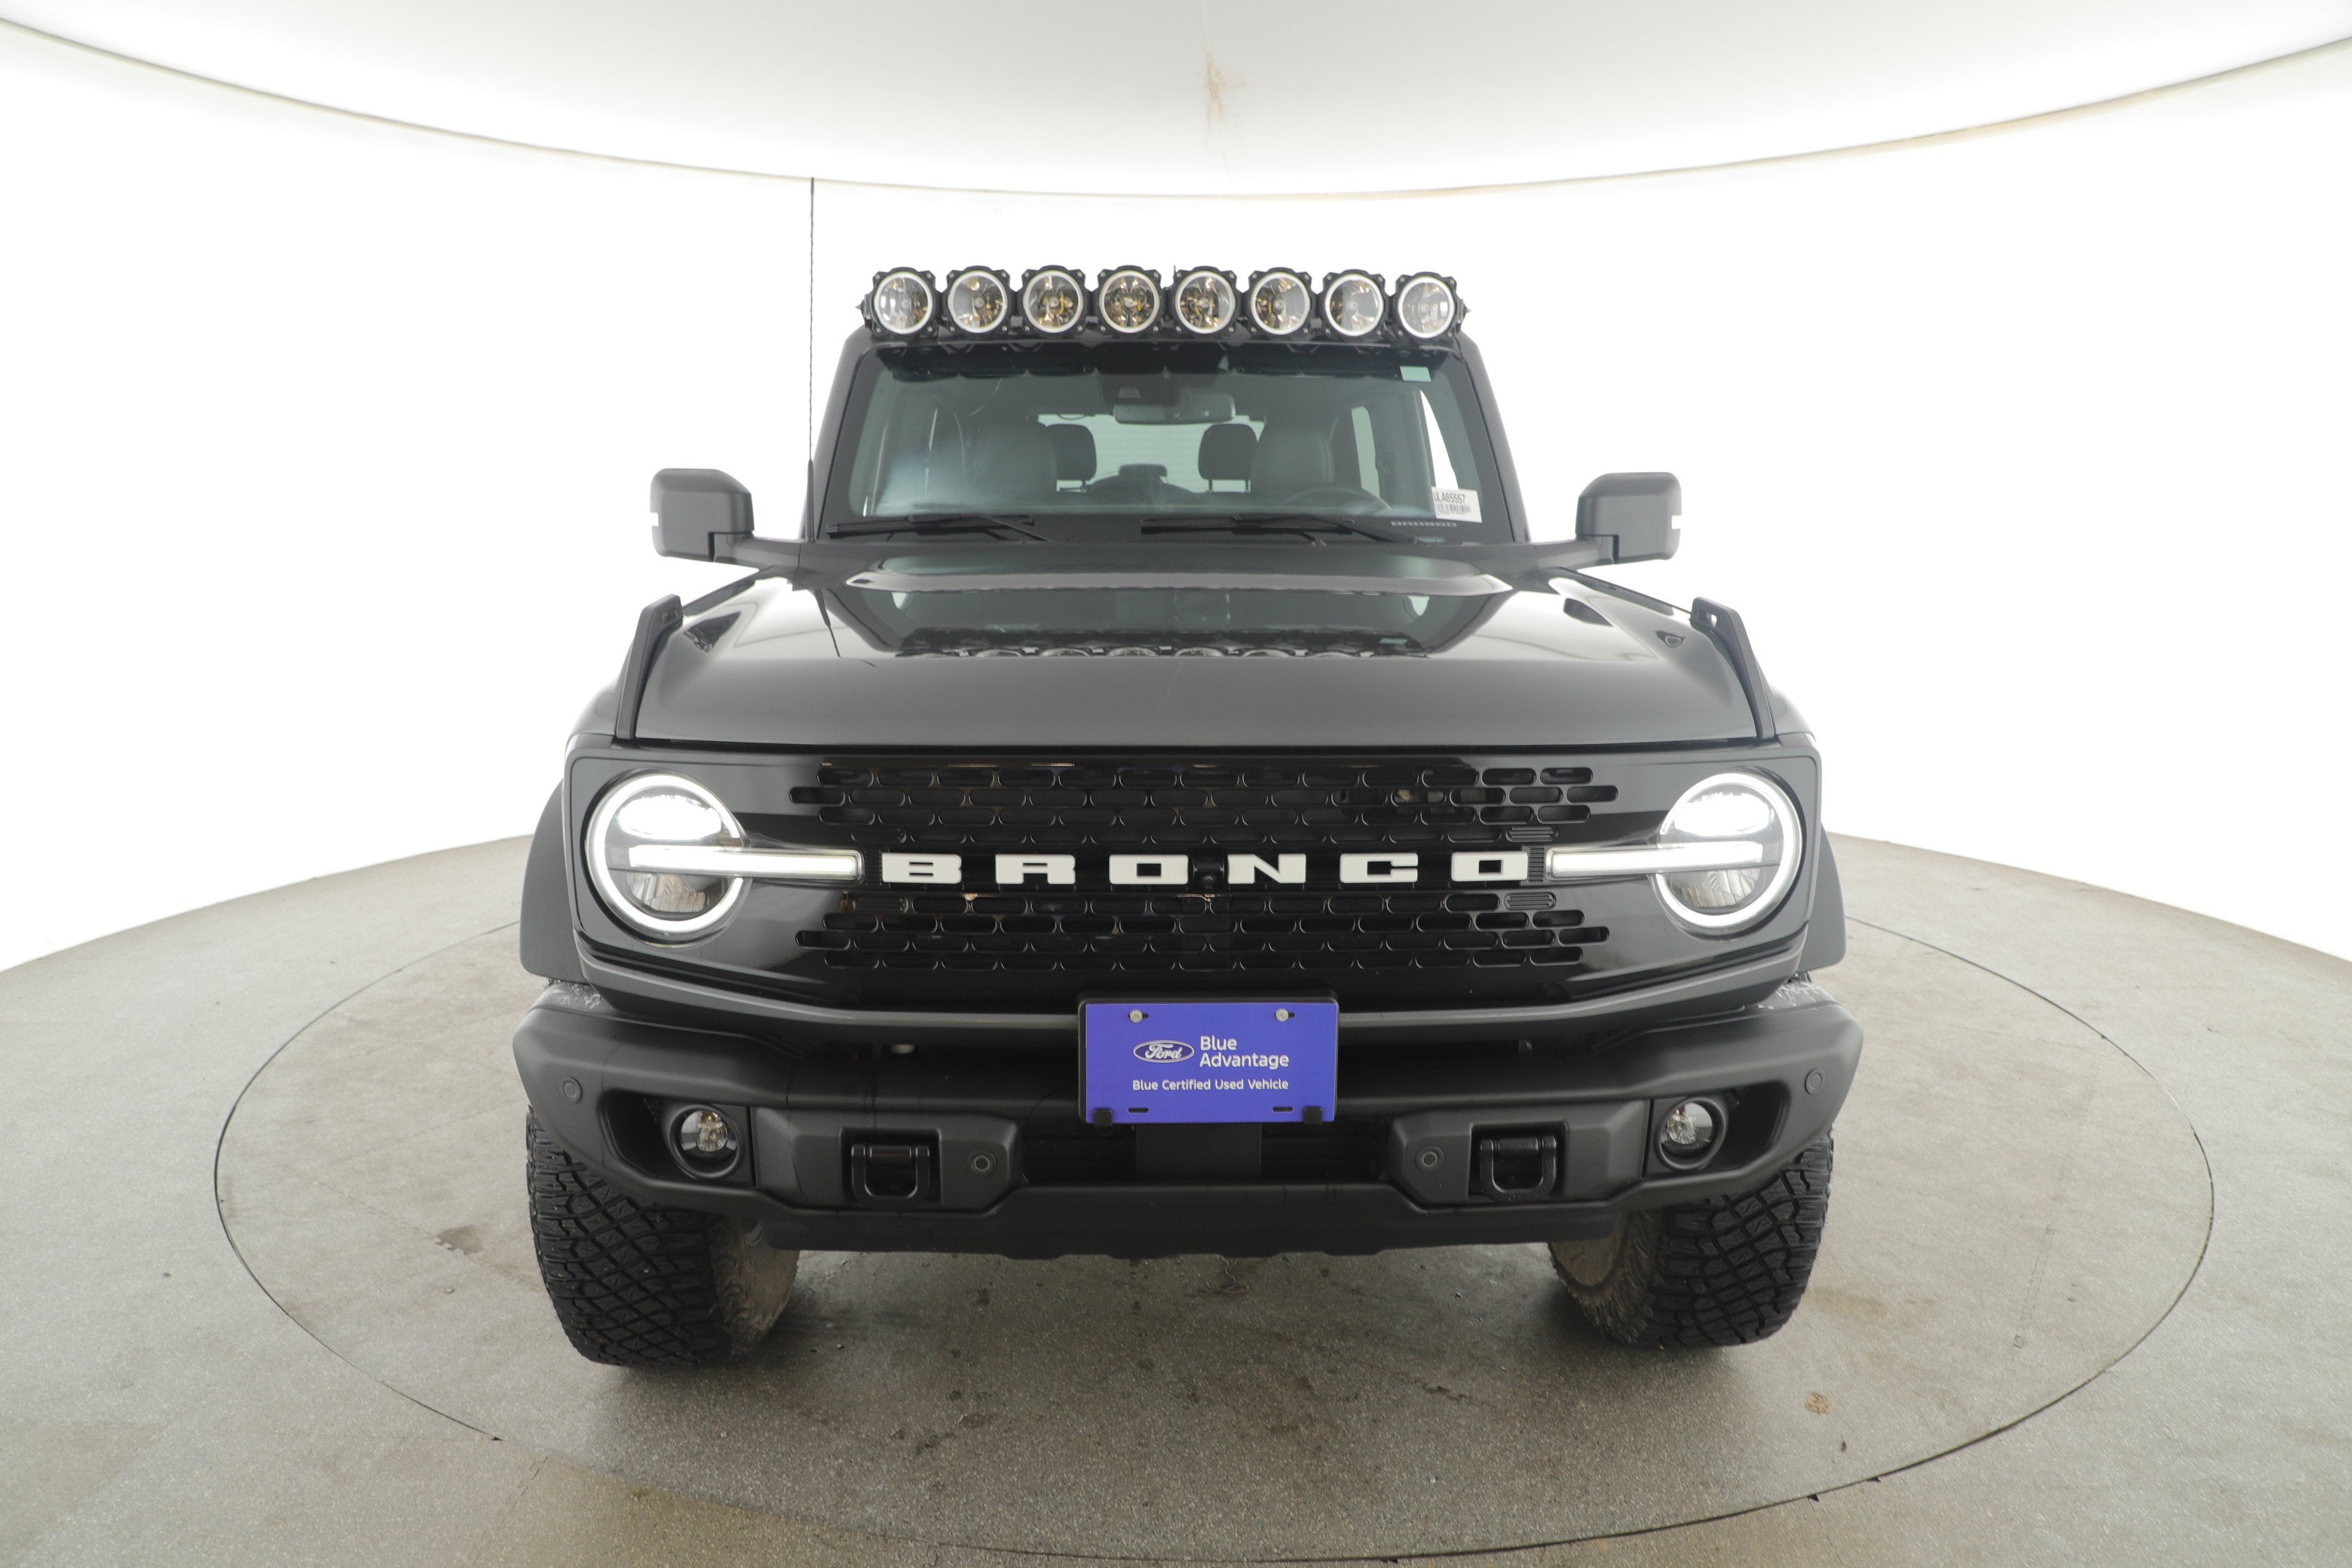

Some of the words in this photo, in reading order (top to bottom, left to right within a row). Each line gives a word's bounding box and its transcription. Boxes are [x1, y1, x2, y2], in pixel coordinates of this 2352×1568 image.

[882, 852, 1529, 885] BRONCO
[1144, 1043, 1183, 1060] Ford
[1200, 1035, 1237, 1051] Blue
[1199, 1052, 1289, 1070] Advantage
[1132, 1079, 1159, 1091] Blue
[1162, 1078, 1211, 1091] Certified
[1214, 1078, 1245, 1090] Used
[1248, 1078, 1289, 1090] Vehicle
